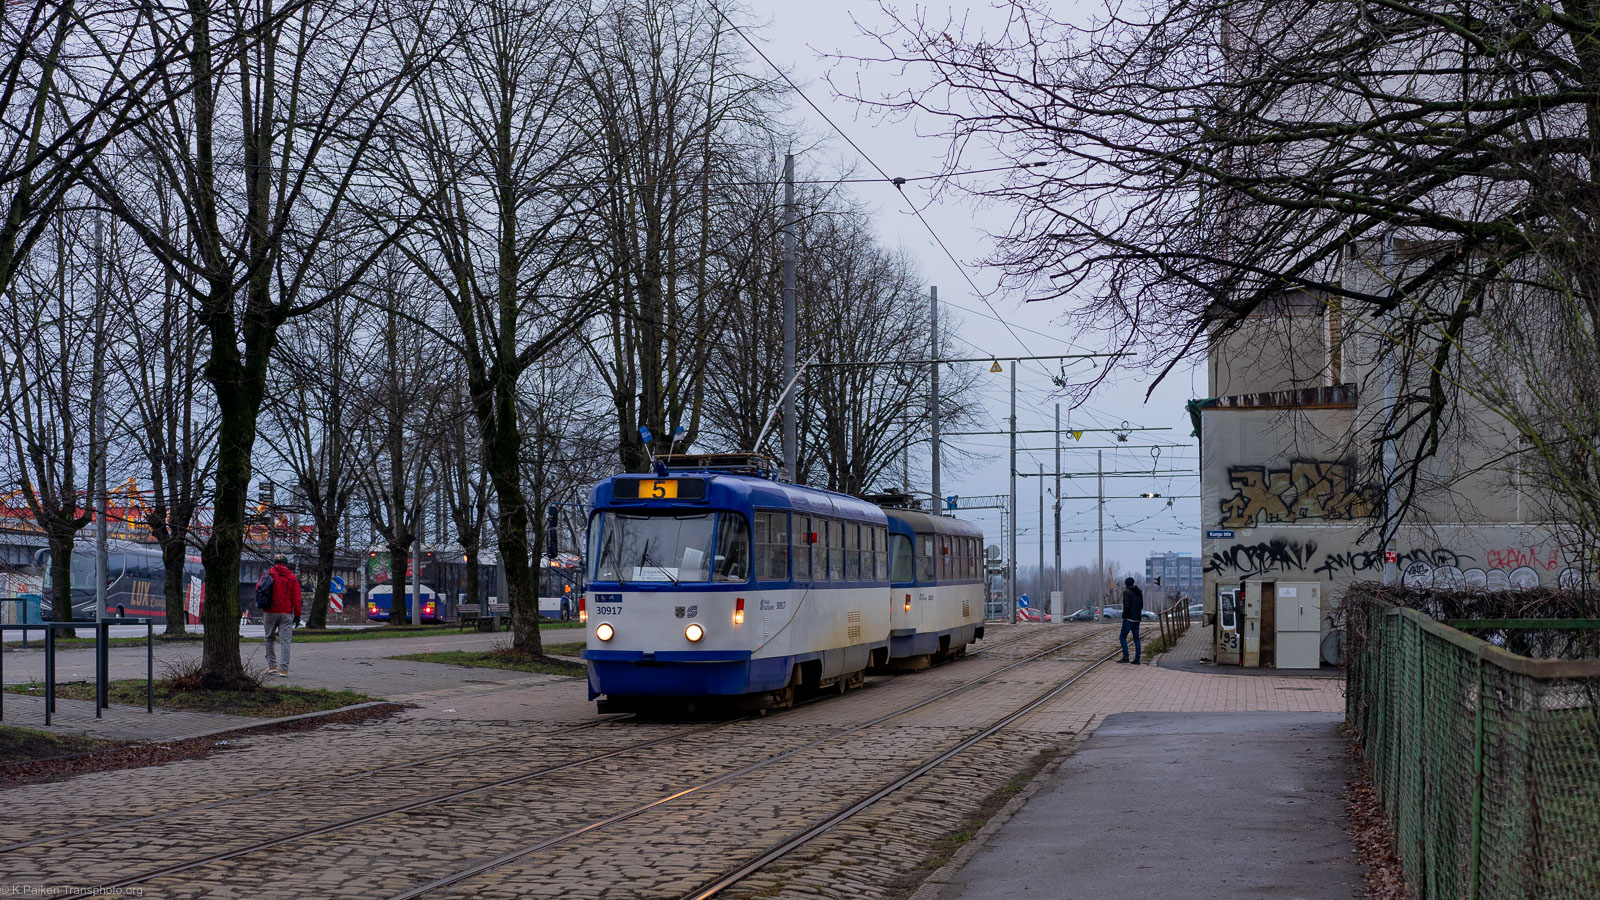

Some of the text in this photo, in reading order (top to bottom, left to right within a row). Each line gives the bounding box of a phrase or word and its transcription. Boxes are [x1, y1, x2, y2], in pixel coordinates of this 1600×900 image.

[652, 480, 666, 498] 5
[131, 580, 152, 606] LUX
[596, 606, 623, 615] 30917
[1219, 629, 1238, 649] 193
